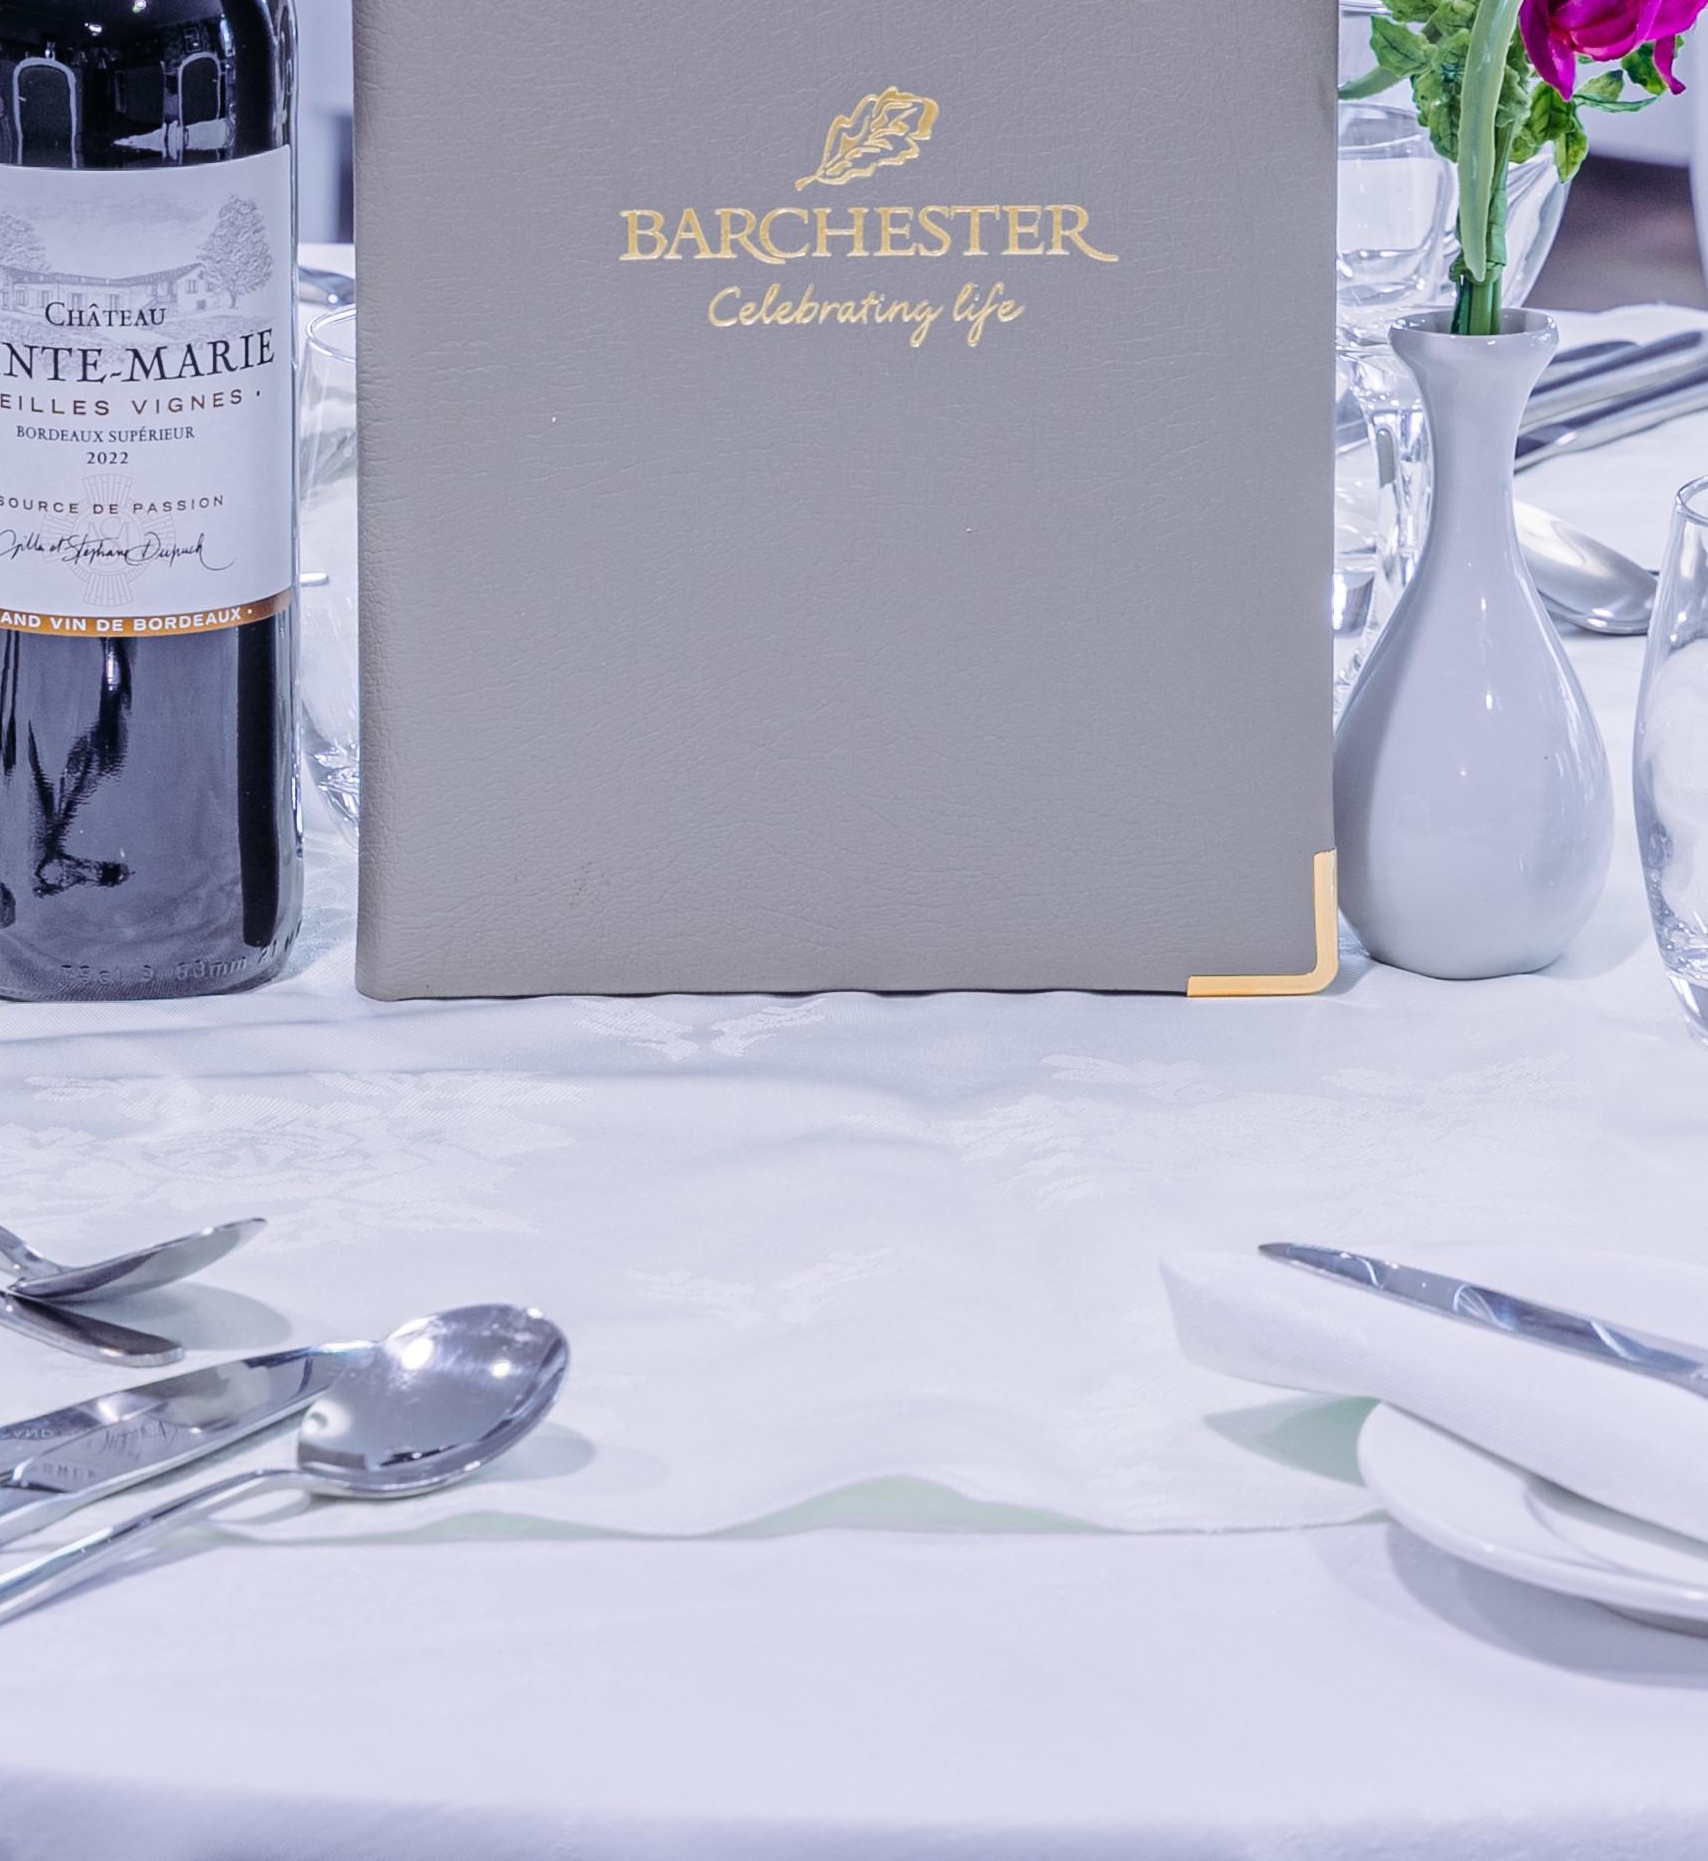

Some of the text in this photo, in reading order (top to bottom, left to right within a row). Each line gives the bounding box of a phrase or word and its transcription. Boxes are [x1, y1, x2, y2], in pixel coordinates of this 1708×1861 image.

[619, 204, 1120, 264] BARCHESTER
[708, 282, 1025, 348] Celebrating life
[132, 389, 242, 415] VIGNES
[16, 425, 195, 443] BORDEAUX SUPÉRIEUR
[86, 451, 129, 465] 2022
[92, 503, 119, 515] DE
[132, 495, 224, 514] PASSION
[50, 618, 87, 631] VIN
[96, 619, 124, 632] DE
[133, 607, 242, 631] BORDEAUX
